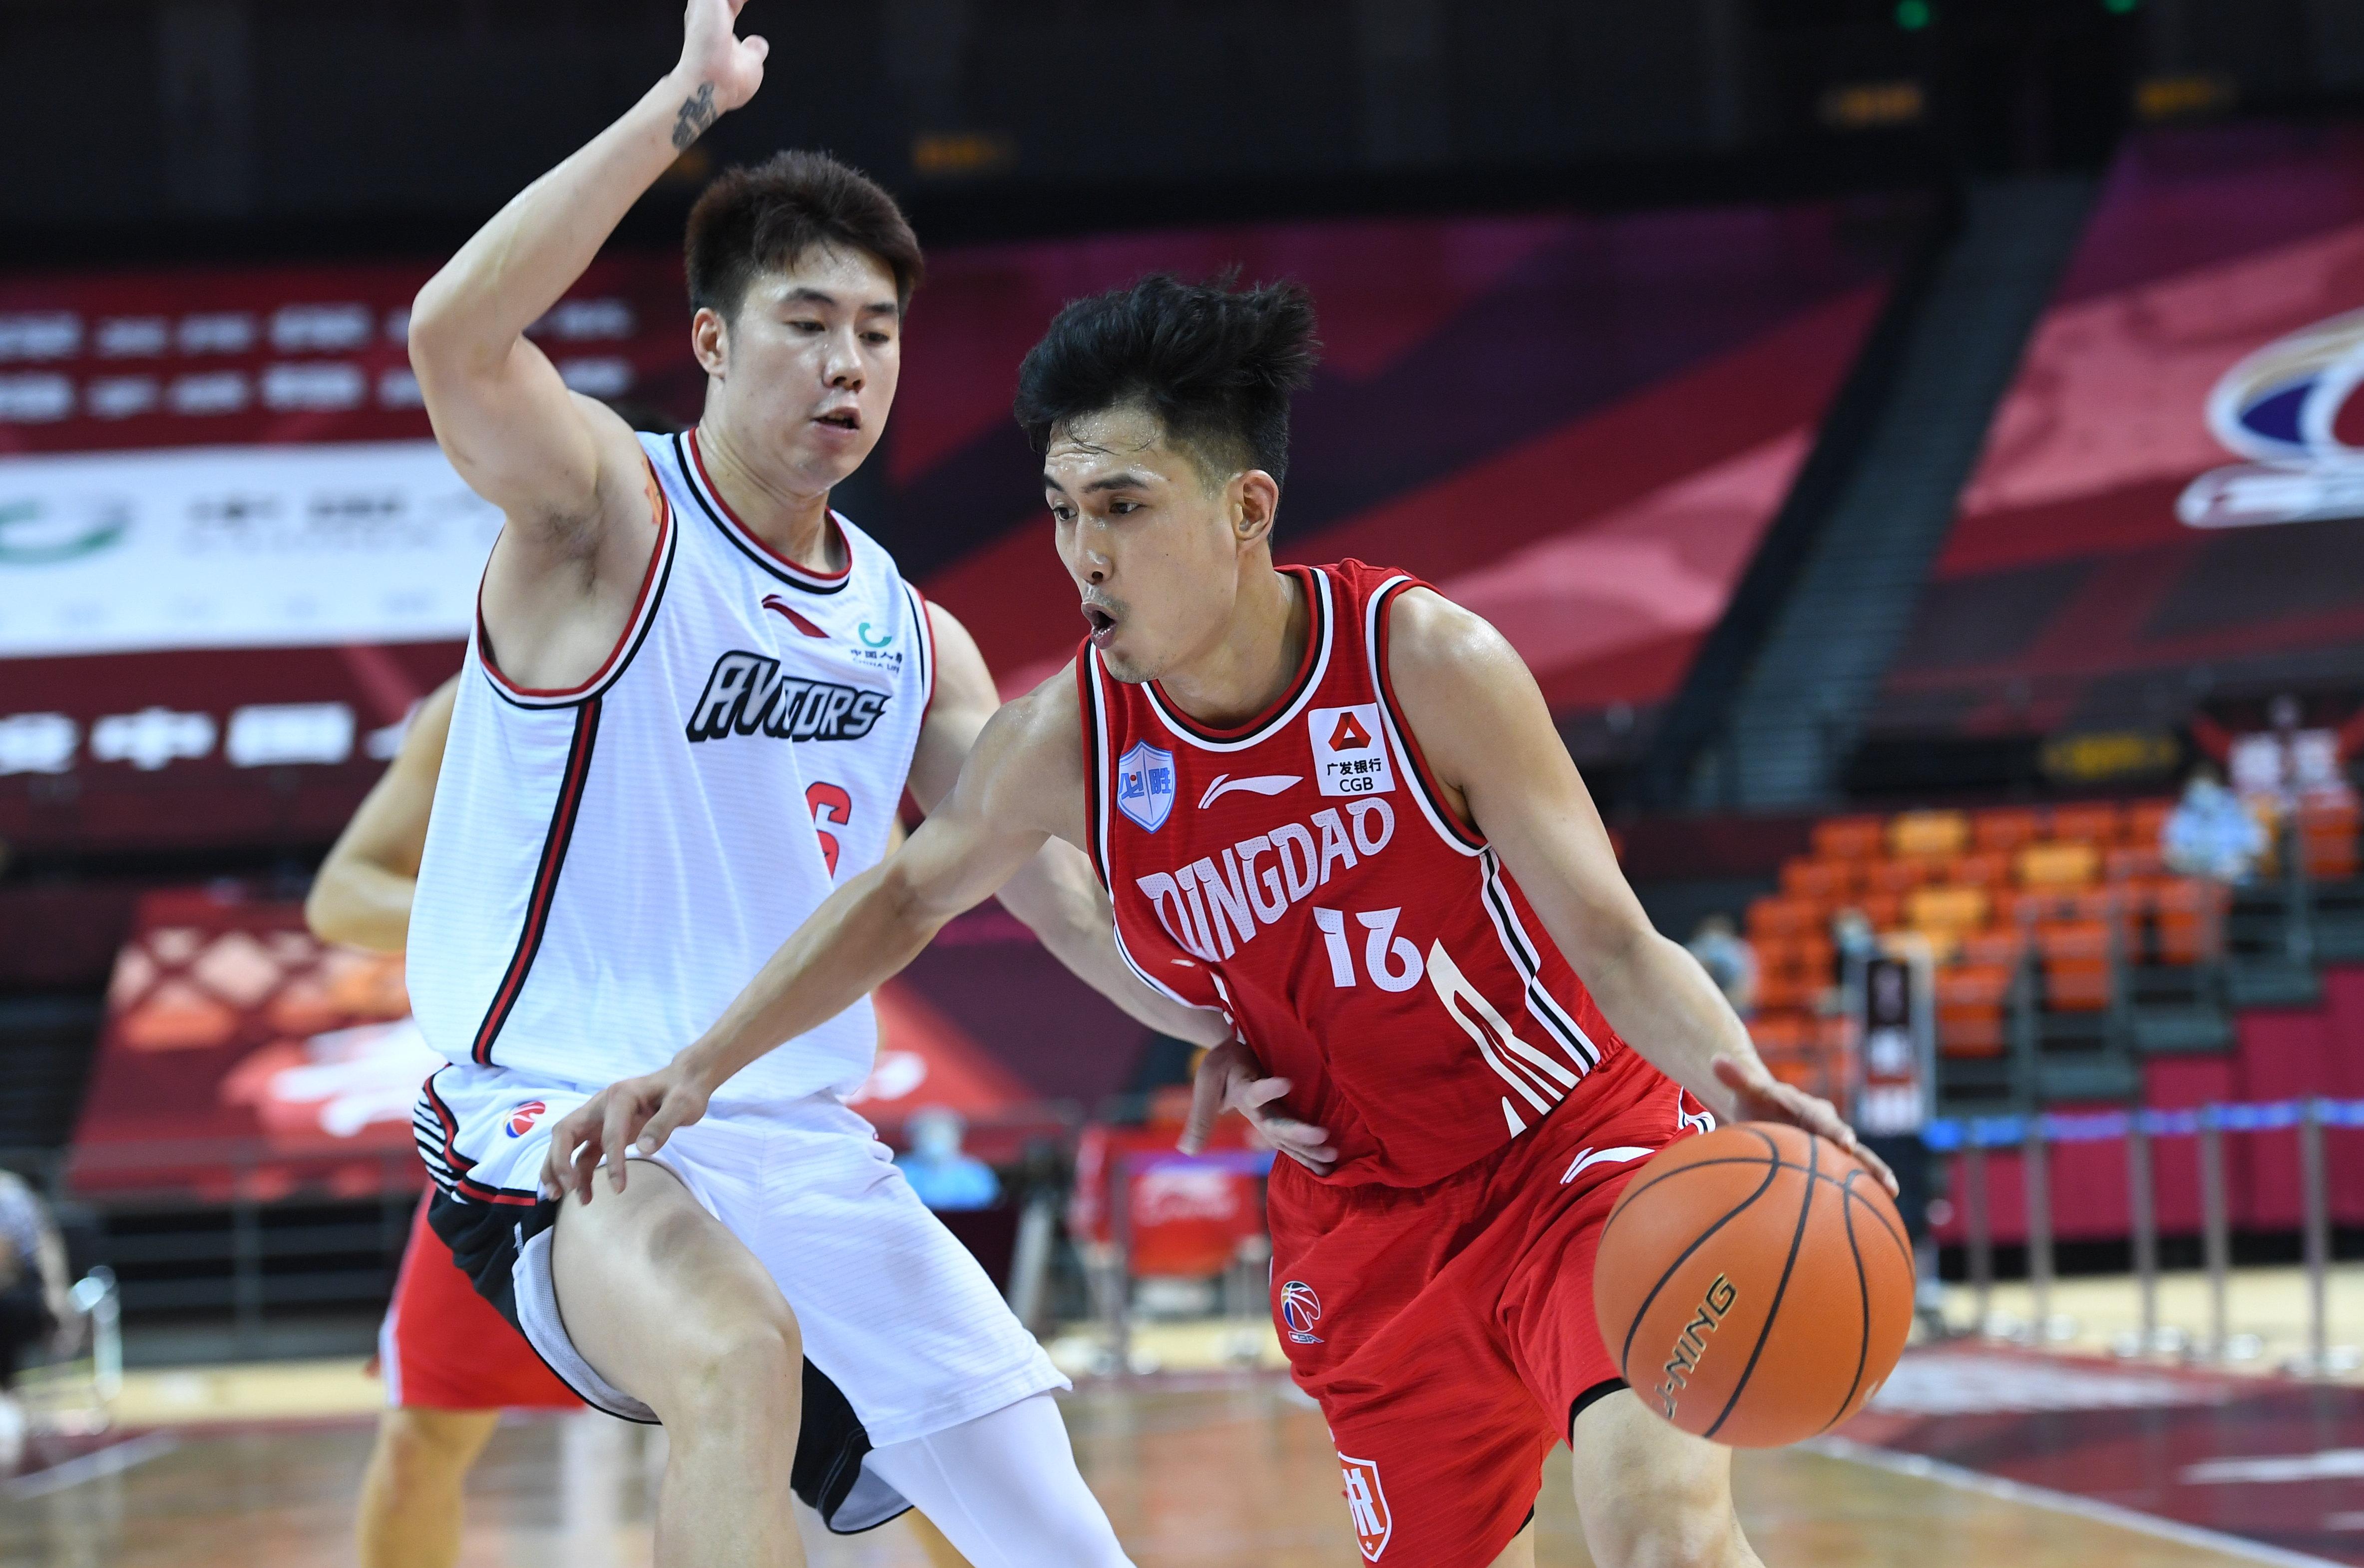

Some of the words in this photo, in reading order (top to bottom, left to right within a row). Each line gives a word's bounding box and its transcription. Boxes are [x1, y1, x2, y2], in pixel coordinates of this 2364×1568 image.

[850, 649, 902, 664] 中国人
[686, 650, 891, 743] AVITORS
[1327, 758, 1382, 776] 广发银行
[1339, 777, 1374, 792] CGB
[1135, 796, 1395, 963] QINGDAO
[1312, 906, 1424, 993] 16
[1288, 1330, 1325, 1344] CBA
